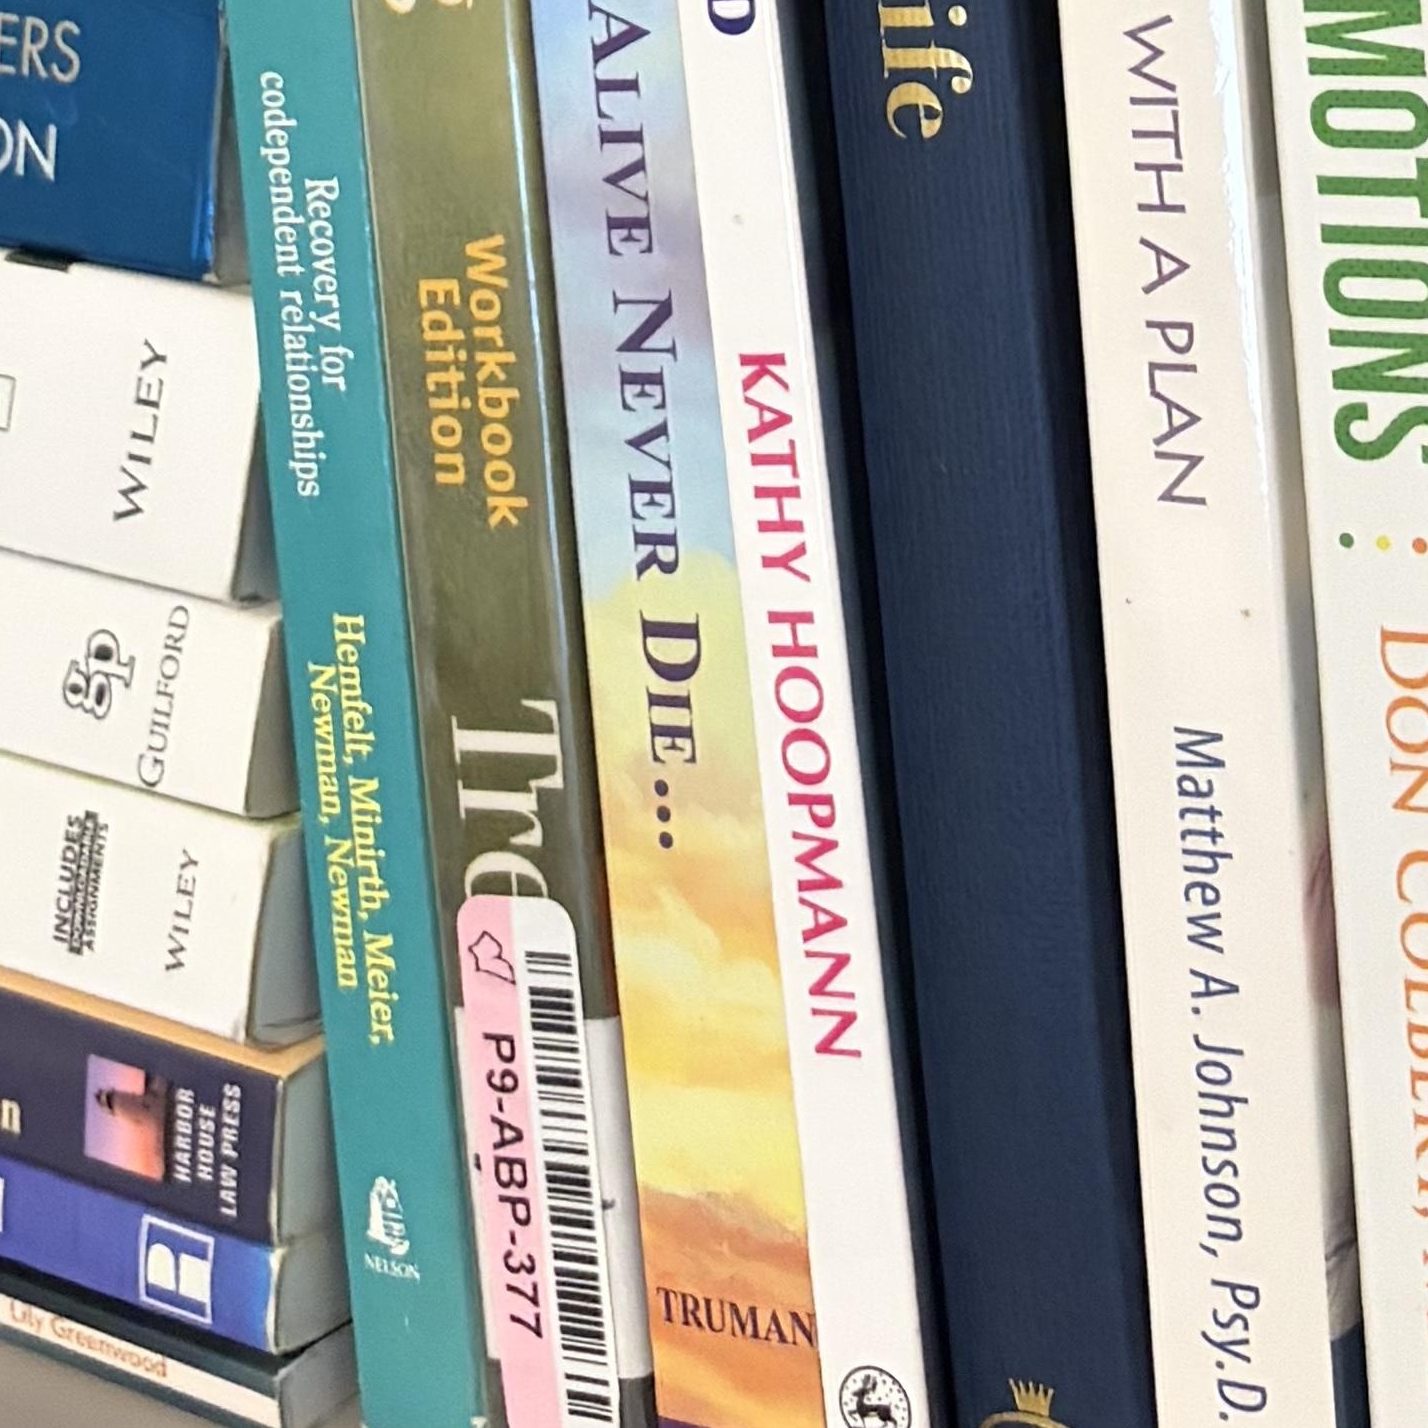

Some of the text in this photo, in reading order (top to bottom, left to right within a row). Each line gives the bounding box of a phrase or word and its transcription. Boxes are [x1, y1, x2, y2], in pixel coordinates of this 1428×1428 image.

[587, 0, 655, 257] ALIVE
[1122, 14, 1186, 213] WITH
[259, 70, 322, 499] codependent relationships
[304, 175, 347, 391] Recovery for
[1139, 236, 1191, 295] A
[112, 339, 172, 525] WILEY
[419, 277, 466, 487] Edition
[464, 234, 530, 532] Workbook
[611, 289, 682, 581] NEVER
[1145, 320, 1208, 508] PLAN
[332, 613, 373, 765] Hemfelt,
[738, 352, 863, 1060] KATHY HOOPMANN
[53, 814, 84, 944] INCLUDES
[164, 848, 199, 971] WILEY
[307, 661, 358, 989] Newman, Newman
[349, 779, 391, 920] Minirth,
[173, 1088, 195, 1183] HARBOR
[196, 1103, 216, 1181] HOUSE
[219, 1083, 241, 1217] LAW PRESS
[1173, 725, 1268, 1424] Matthew A. Johnson, Psy.D.
[481, 1031, 544, 1339] P9-ABP-377
[50, 1316, 168, 1378] Greenwood
[657, 1287, 817, 1347] TRUMAN
